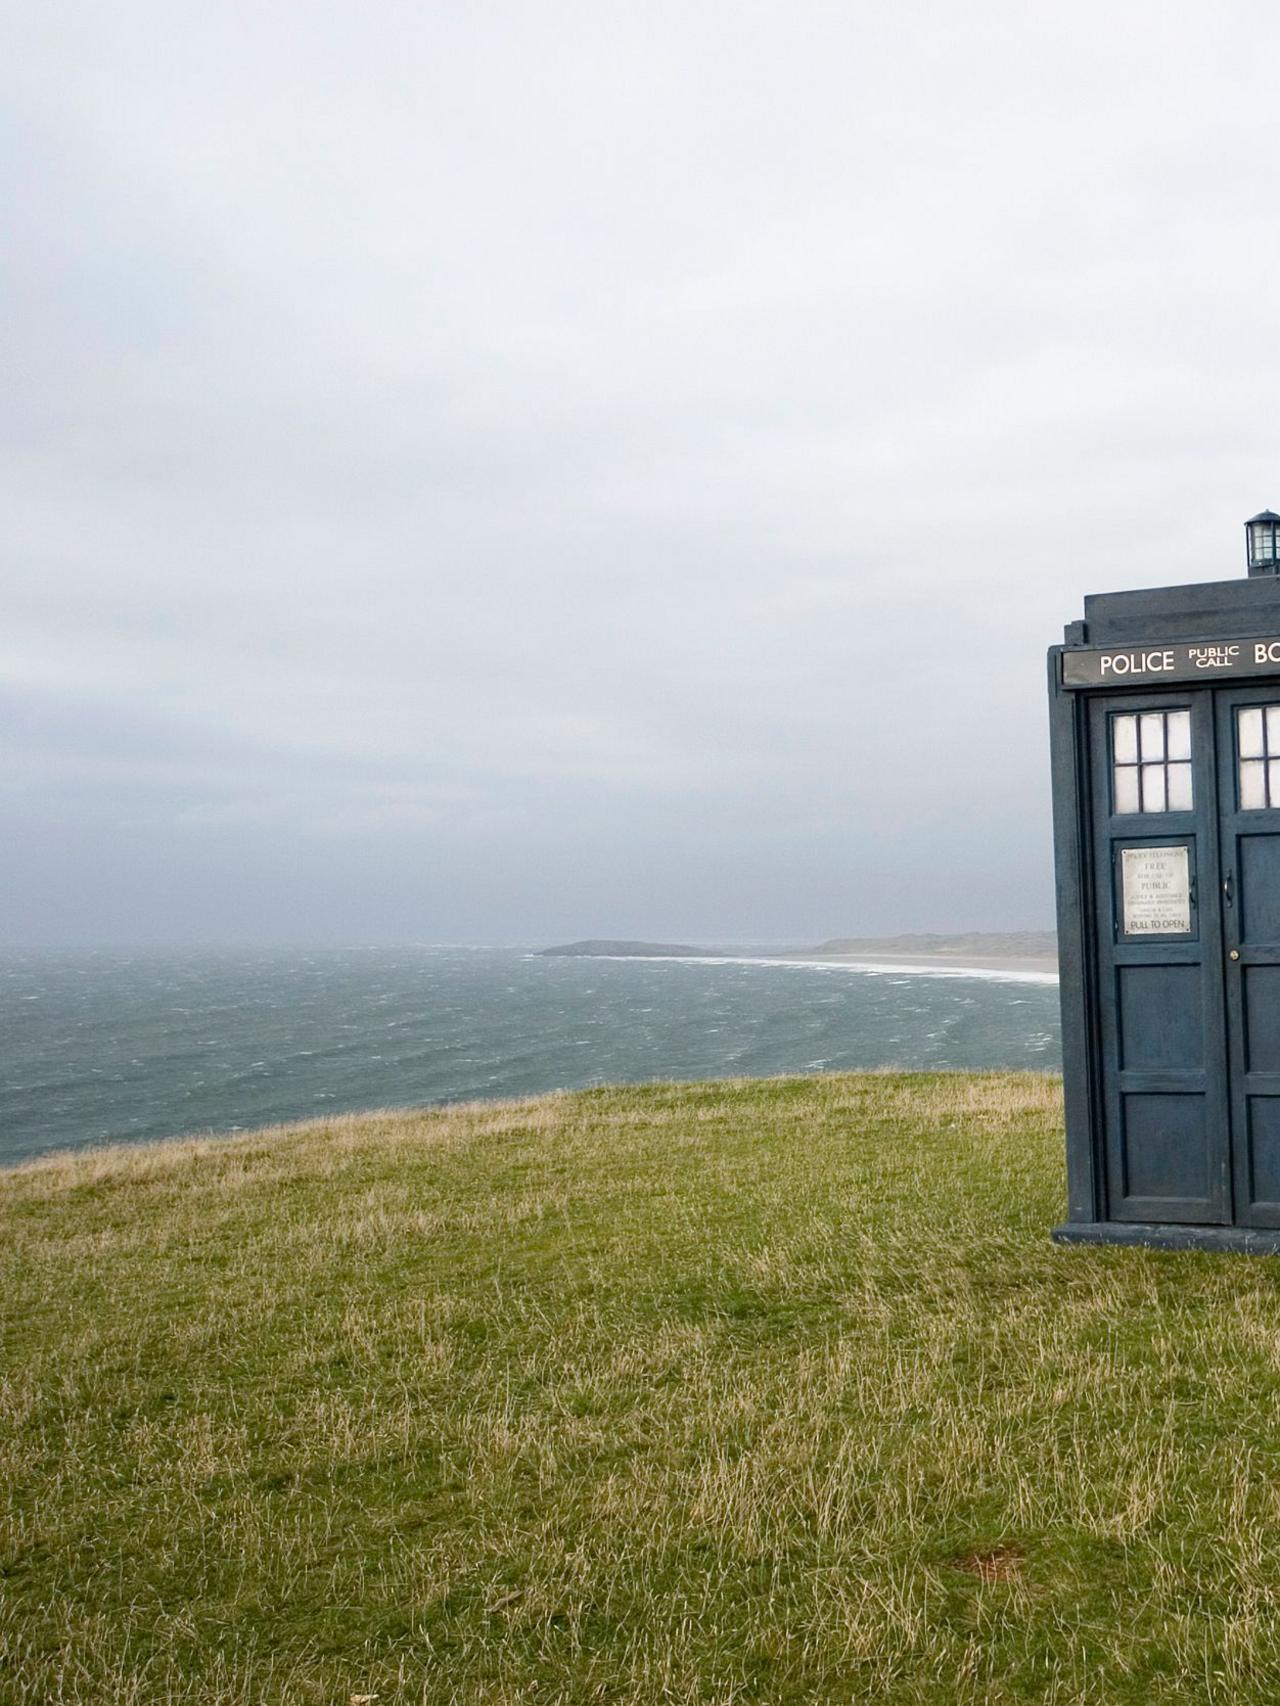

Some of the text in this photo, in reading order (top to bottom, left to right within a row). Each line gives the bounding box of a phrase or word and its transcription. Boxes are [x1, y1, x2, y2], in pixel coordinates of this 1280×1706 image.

[1188, 645, 1239, 659] PUBLIC
[1100, 651, 1174, 675] POLICE
[1195, 656, 1232, 668] CALL
[1130, 919, 1185, 930] PULL TO OPEN
